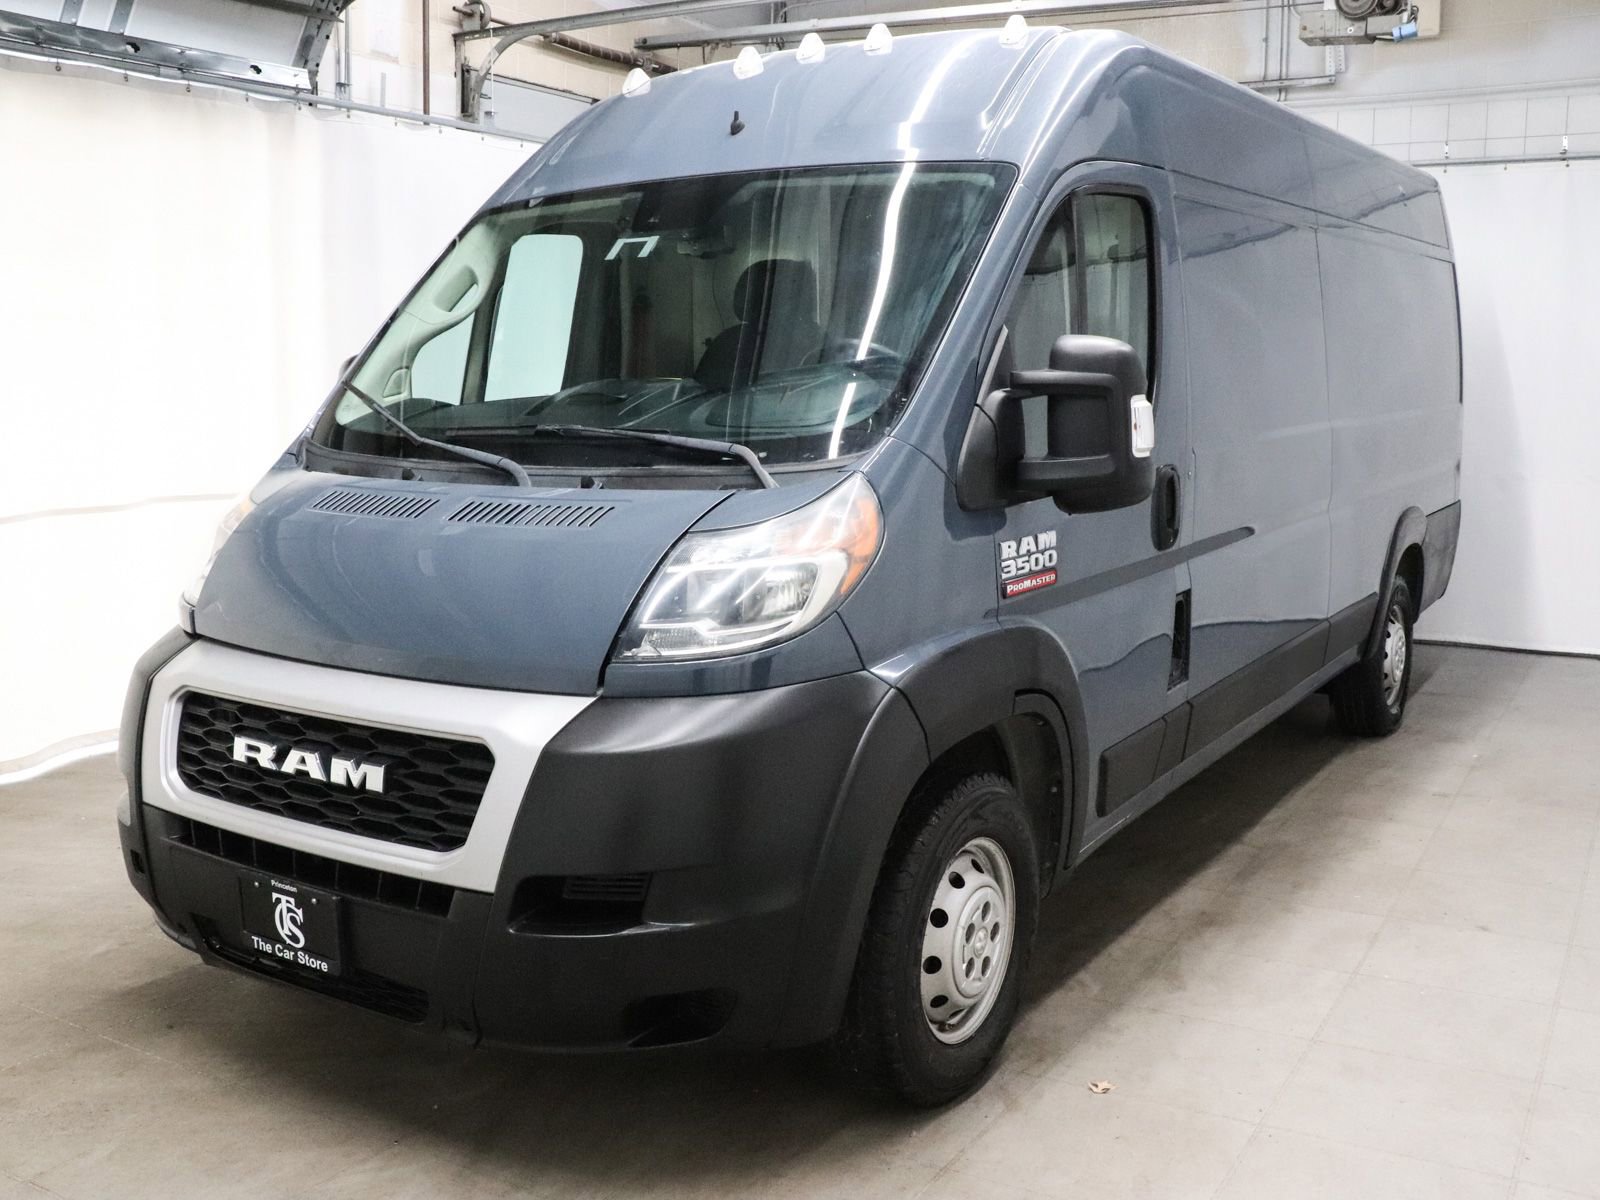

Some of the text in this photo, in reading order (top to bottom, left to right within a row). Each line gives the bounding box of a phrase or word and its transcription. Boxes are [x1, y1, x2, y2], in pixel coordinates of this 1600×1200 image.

[1000, 529, 1057, 560] RAM
[1001, 549, 1058, 580] 3500
[232, 735, 385, 793] RAM
[271, 879, 298, 893] Princeton
[251, 935, 329, 972] The Car Store
